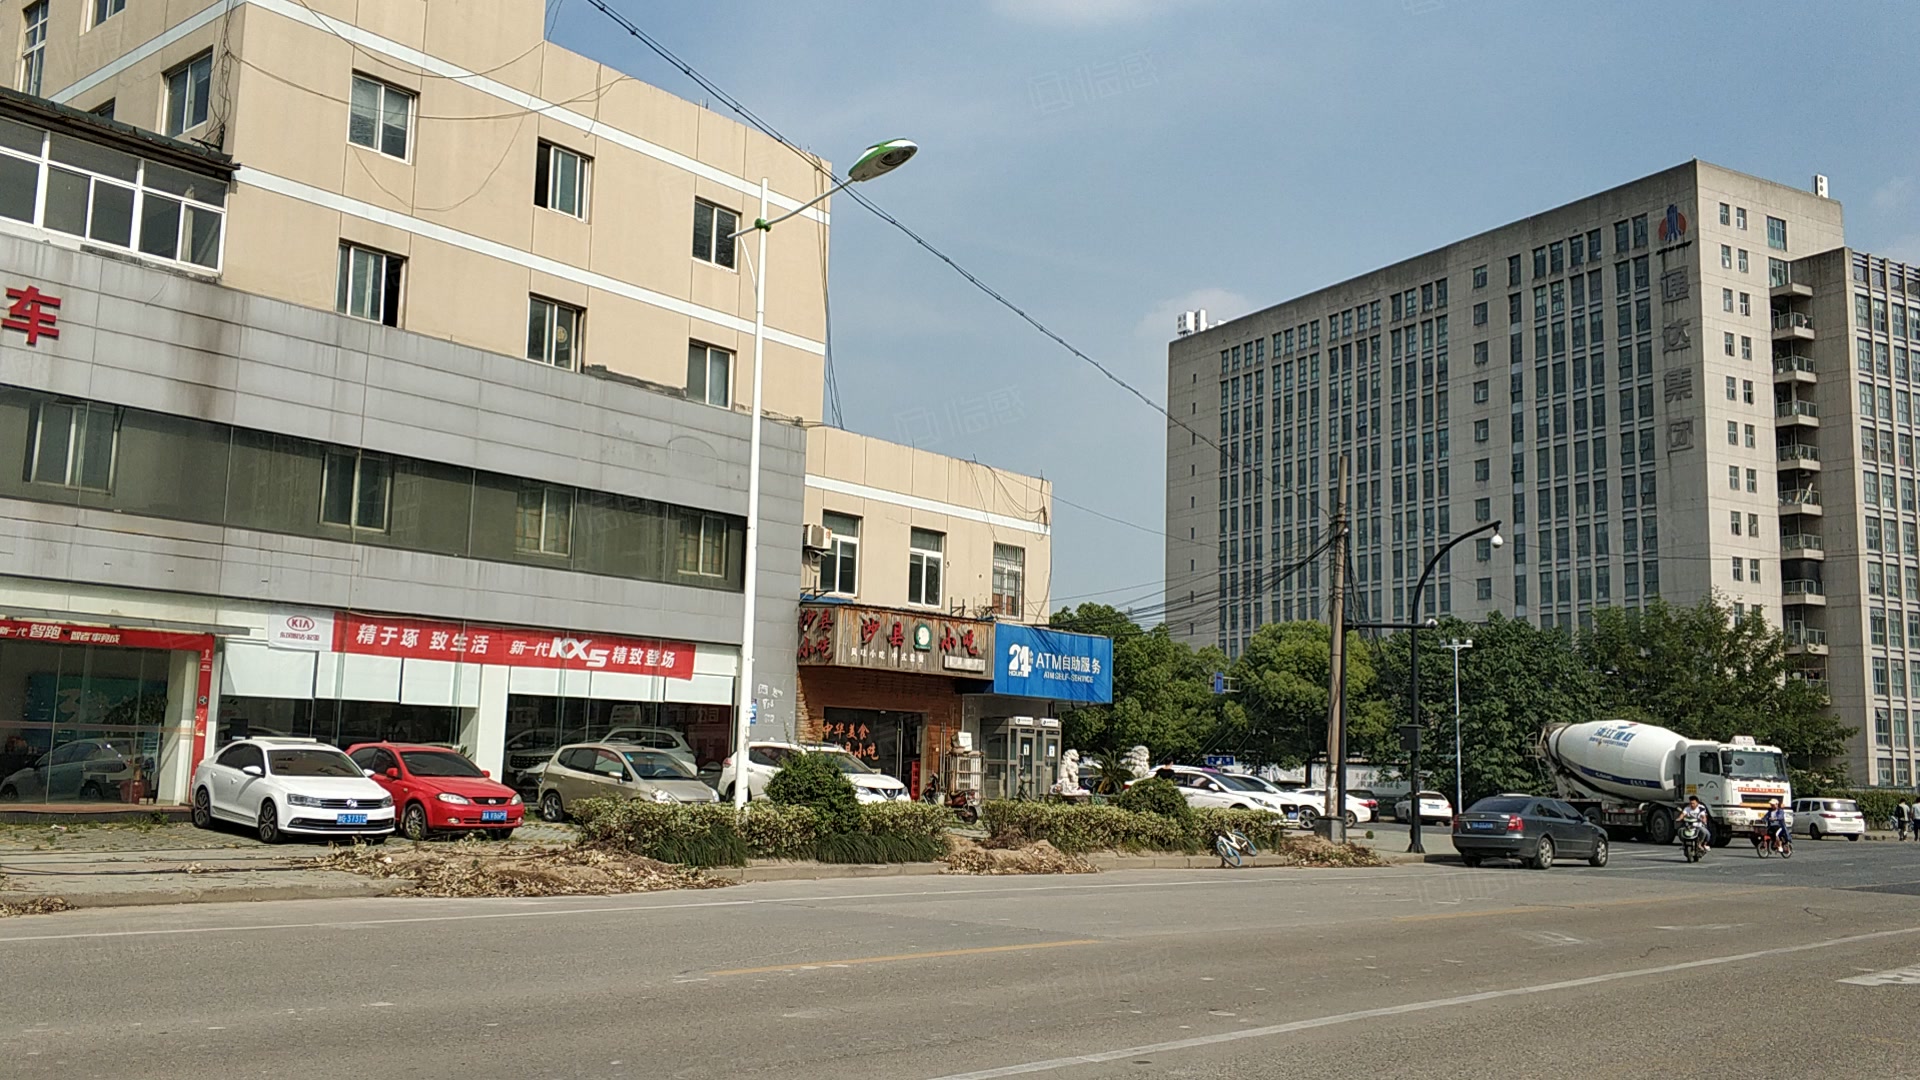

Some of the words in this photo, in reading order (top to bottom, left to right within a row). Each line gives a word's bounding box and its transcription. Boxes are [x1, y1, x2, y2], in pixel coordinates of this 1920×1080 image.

[1, 285, 61, 346] 车
[1661, 266, 1694, 452] 通达集团
[291, 618, 310, 629] KIA
[861, 617, 905, 648] 沙县
[940, 626, 978, 655] 小吃
[356, 623, 421, 648] 精于琢
[429, 631, 489, 654] 致生活
[611, 646, 675, 668] 精致登场
[1008, 643, 1032, 677] 24
[1035, 652, 1101, 675] ATM自助服务
[822, 721, 869, 740] 中华美食
[834, 741, 879, 760] 县小吃
